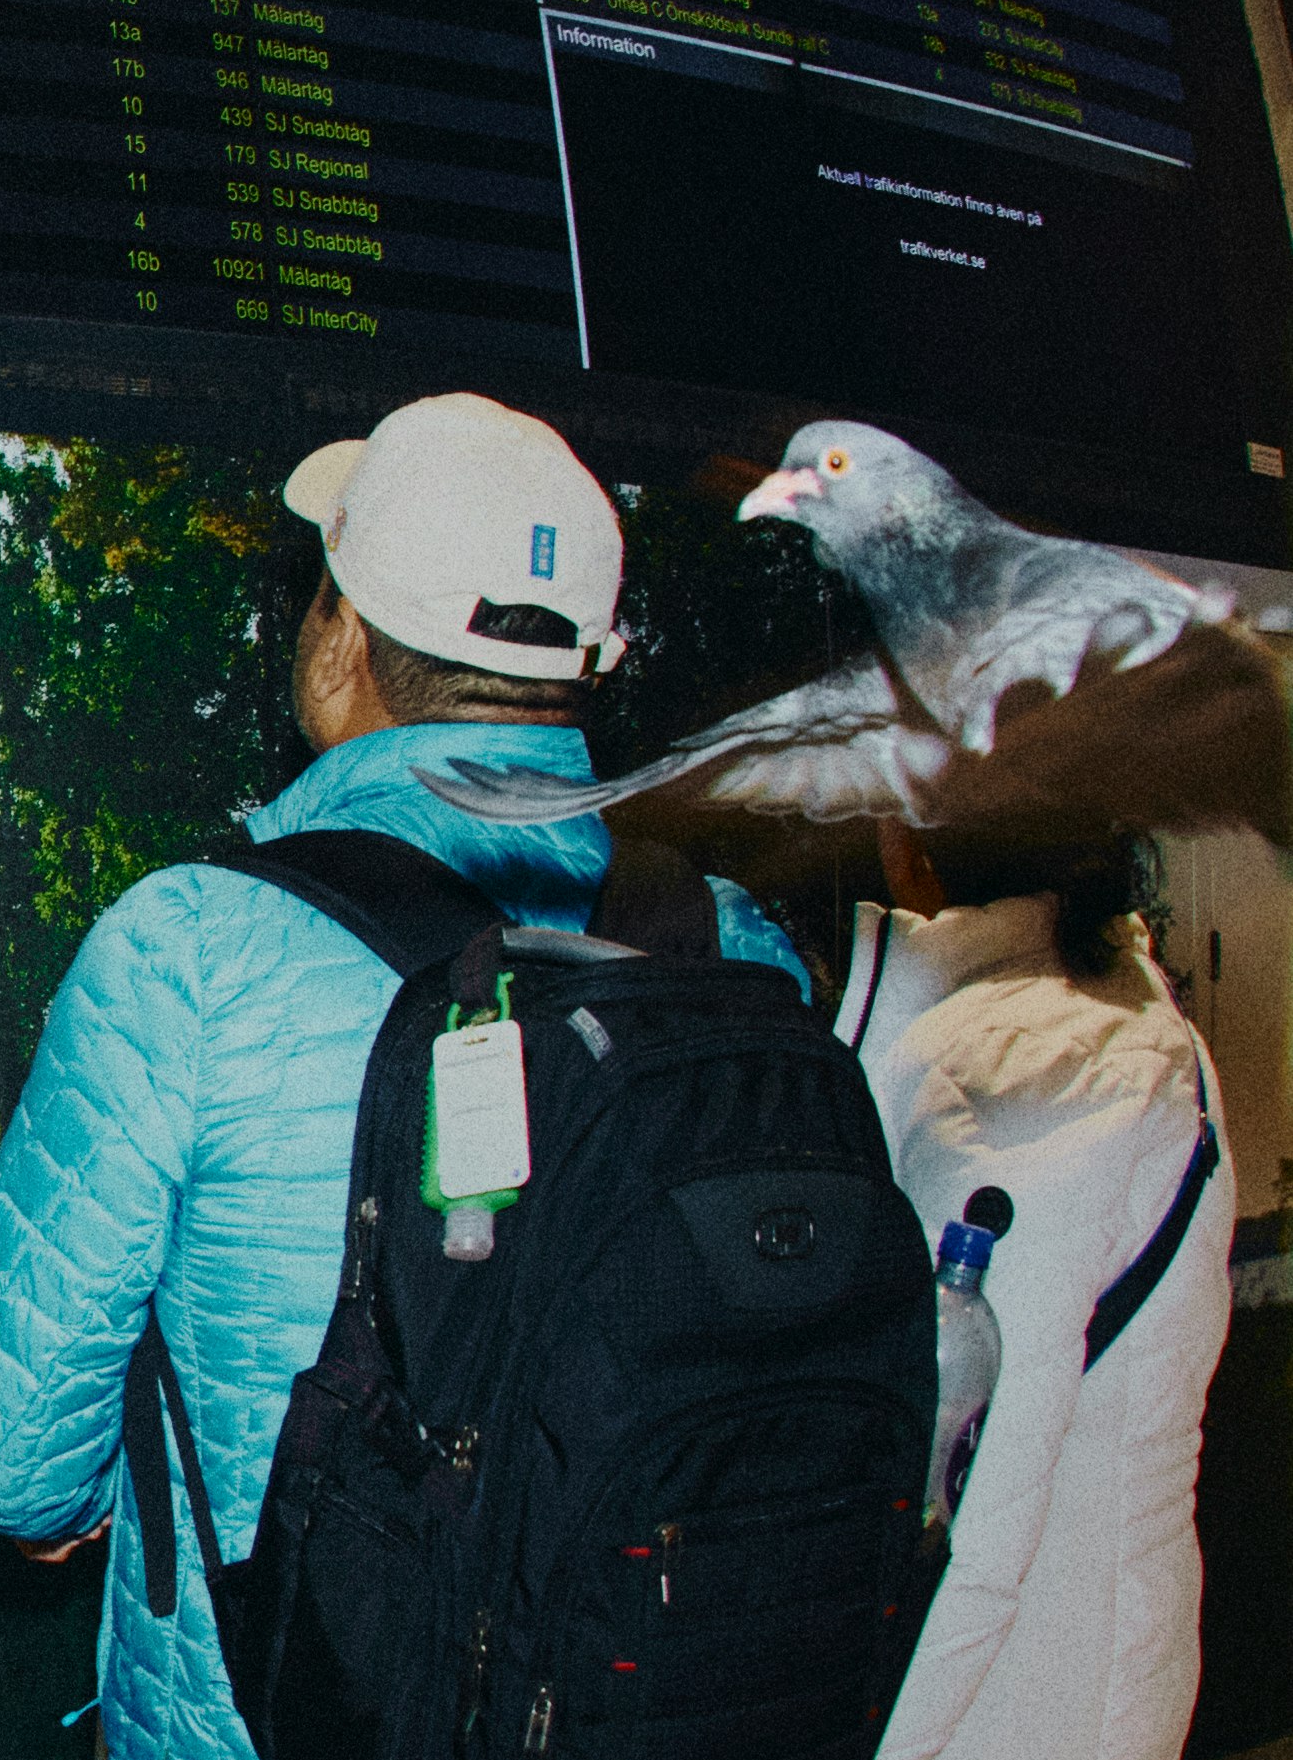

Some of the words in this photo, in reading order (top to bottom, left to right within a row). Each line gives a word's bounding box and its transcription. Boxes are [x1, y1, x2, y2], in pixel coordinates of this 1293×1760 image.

[253, 3, 324, 34] Mälartåg
[257, 39, 329, 70] Mälartåg
[557, 25, 655, 58] Information
[261, 76, 333, 106] Mälartåg
[220, 107, 252, 127] 439
[265, 112, 286, 132] SJ
[292, 115, 370, 147] Snabbtåg
[225, 144, 256, 165] 179
[269, 149, 291, 170] SJ
[296, 153, 368, 179] Regional
[227, 182, 259, 202] 539
[272, 187, 294, 208] SJ
[299, 191, 378, 223] Snabbtåg
[818, 165, 861, 186] Aktuell
[864, 175, 963, 207] trafikinformation
[965, 196, 994, 216] finns
[996, 204, 1025, 222] även
[1026, 211, 1043, 228] på
[230, 221, 262, 242] 578
[276, 226, 298, 247] SJ
[303, 229, 382, 261] Snabbtåg
[128, 251, 160, 271] 16b
[213, 258, 264, 280] 10921
[900, 240, 986, 269] trafikverket.se
[279, 265, 352, 296] Mälartåg
[236, 299, 268, 321] 669
[282, 304, 304, 325] SJ
[310, 308, 377, 337] InterCity
